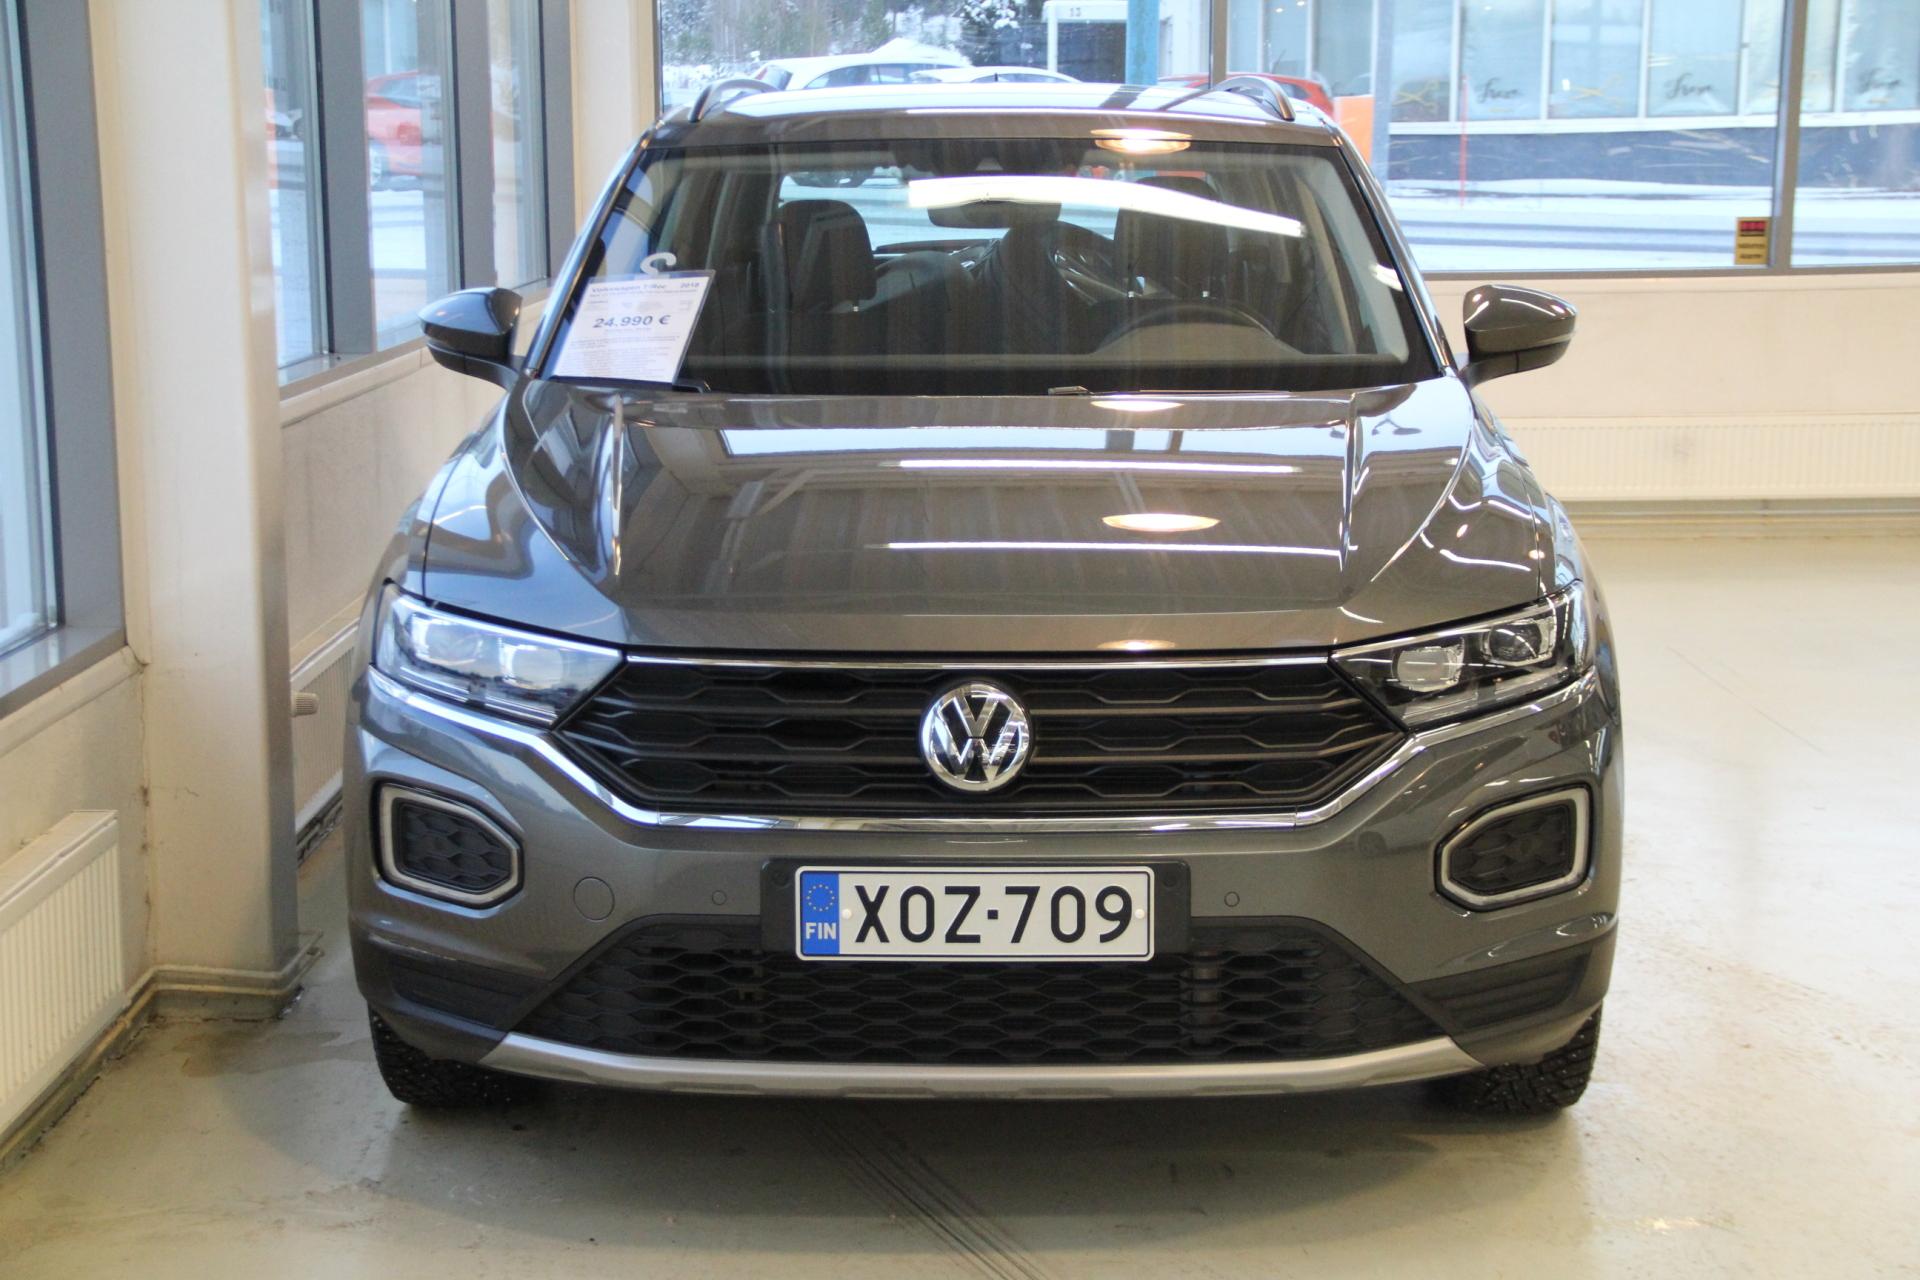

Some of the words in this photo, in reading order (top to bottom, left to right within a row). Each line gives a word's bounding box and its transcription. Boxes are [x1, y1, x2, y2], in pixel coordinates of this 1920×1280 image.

[592, 315, 653, 328] 24.990
[659, 314, 672, 325] €
[854, 885, 1133, 944] XOZ-709
[805, 922, 837, 940] FIN
